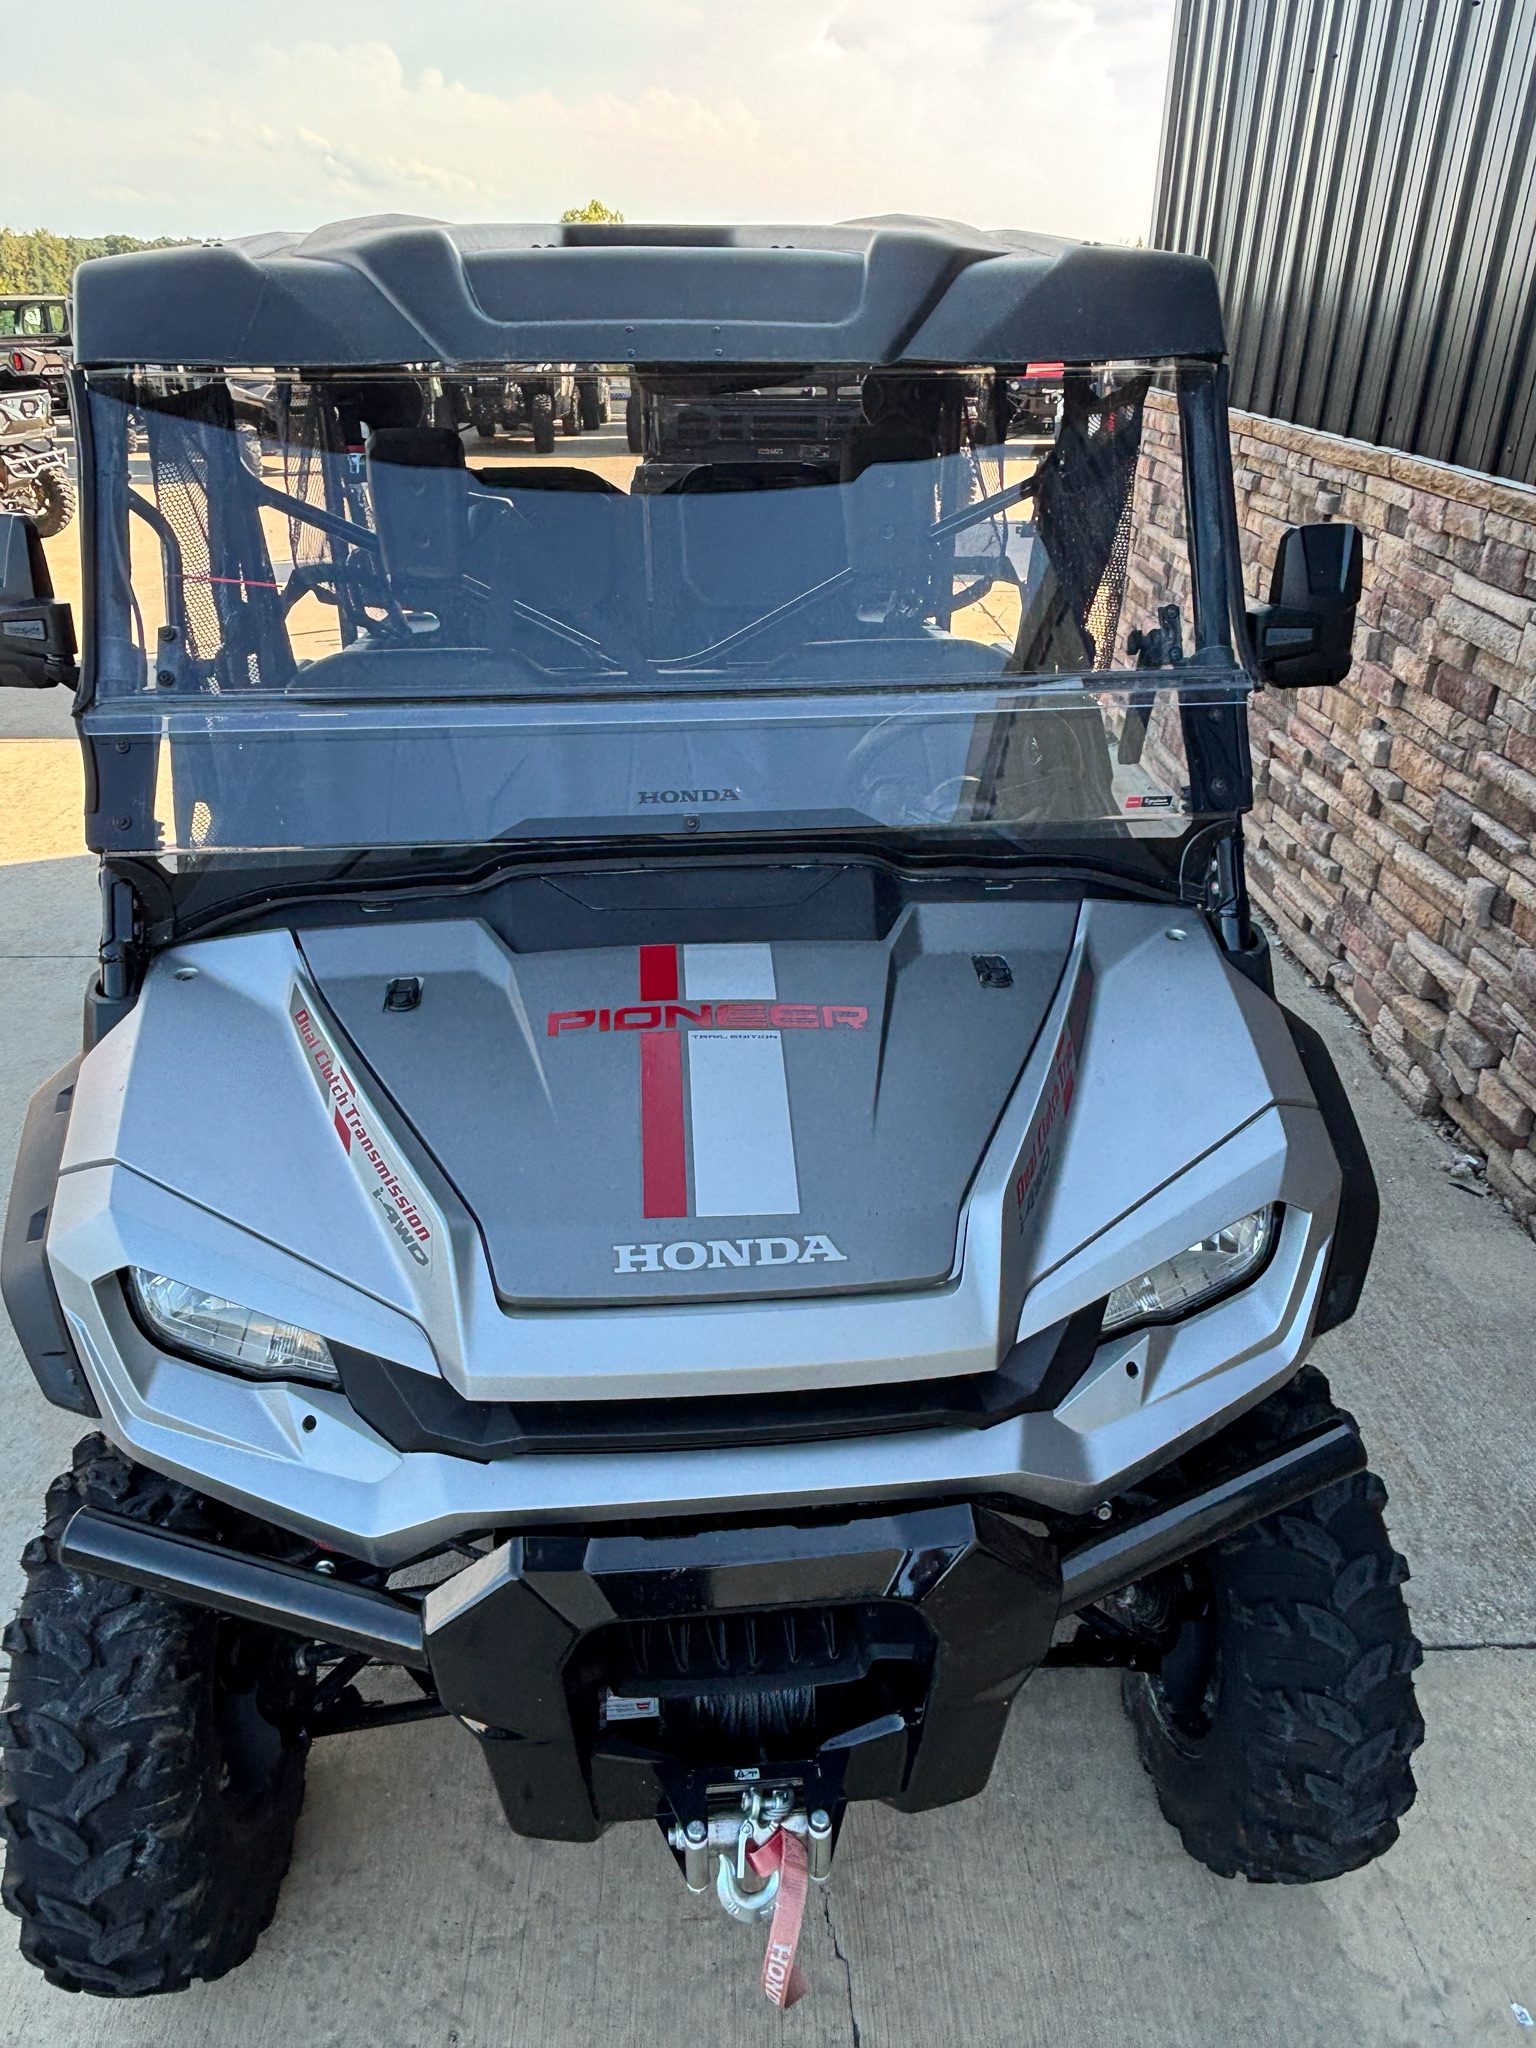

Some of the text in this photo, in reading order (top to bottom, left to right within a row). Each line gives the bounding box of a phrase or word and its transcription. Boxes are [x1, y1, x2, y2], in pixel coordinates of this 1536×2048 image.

[638, 789, 740, 804] HONDA
[547, 1004, 868, 1037] PIONEER
[294, 1009, 430, 1242] Dual Clutch Transmission
[613, 1234, 848, 1273] HONDA
